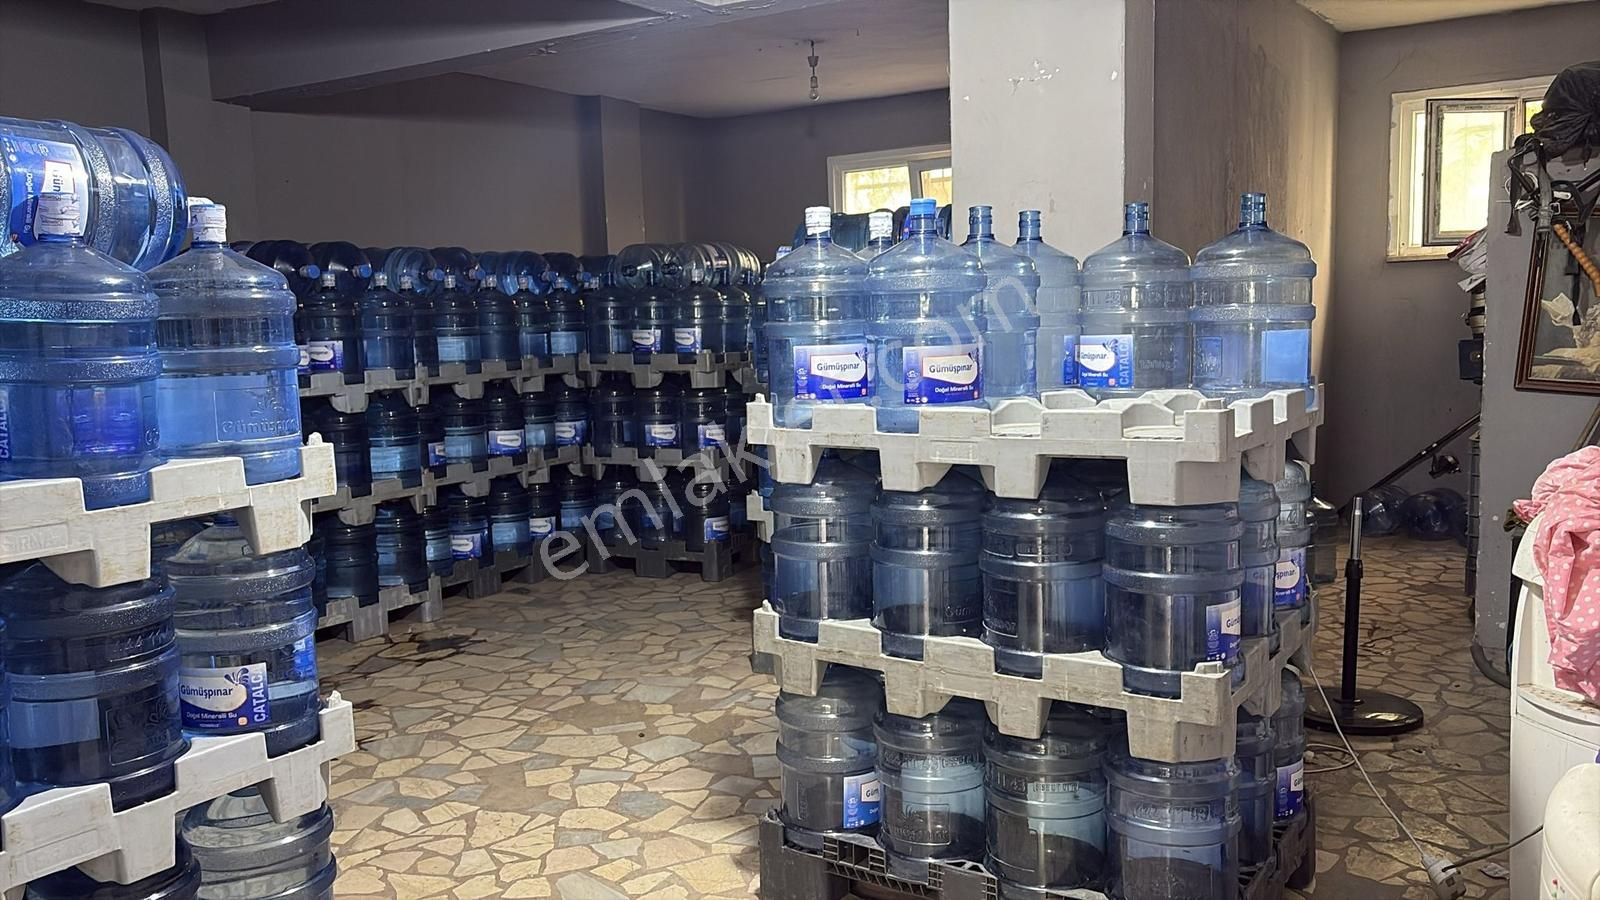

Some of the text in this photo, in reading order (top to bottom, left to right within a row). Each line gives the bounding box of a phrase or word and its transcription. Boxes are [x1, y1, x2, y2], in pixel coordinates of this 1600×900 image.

[817, 362, 860, 372] Gümüşpınar
[929, 364, 973, 374] Gümüşpınar
[180, 684, 234, 700] Gümüşpınar
